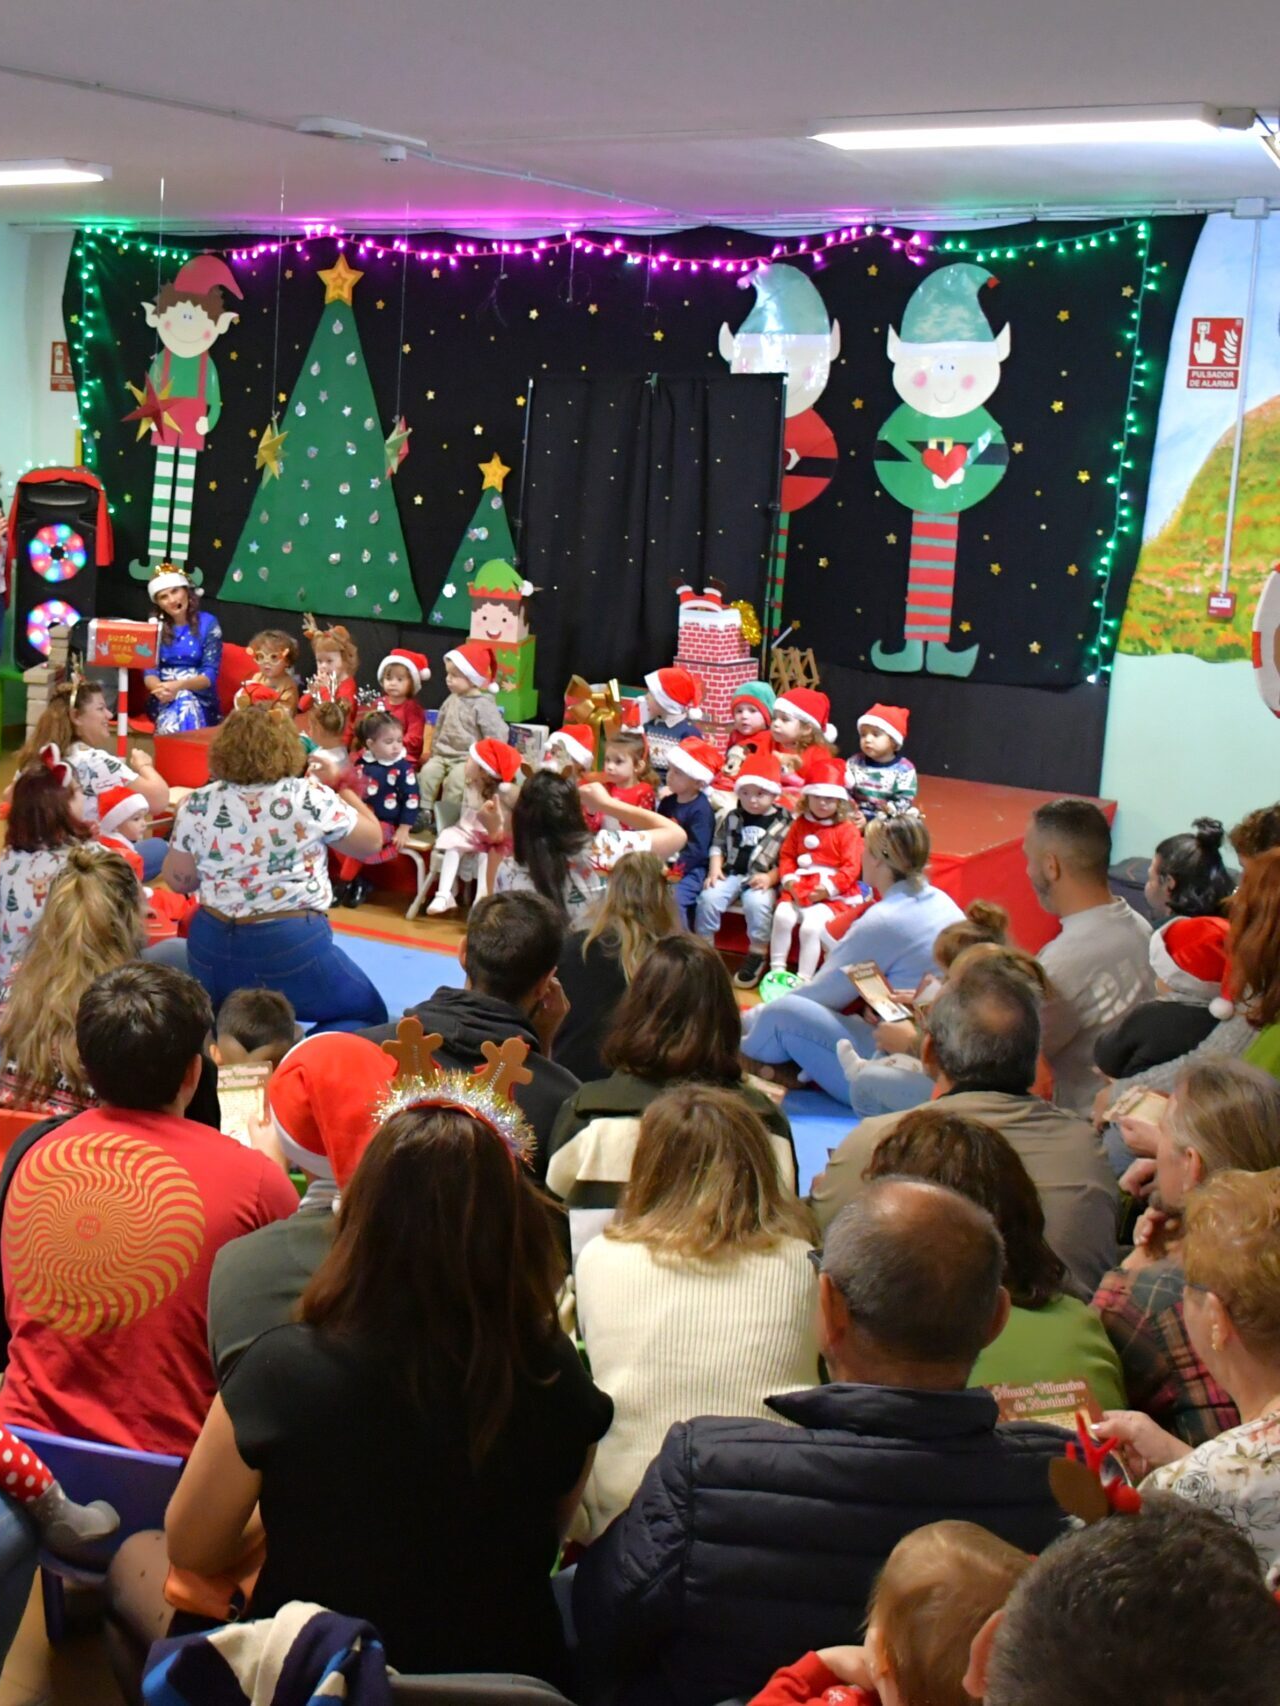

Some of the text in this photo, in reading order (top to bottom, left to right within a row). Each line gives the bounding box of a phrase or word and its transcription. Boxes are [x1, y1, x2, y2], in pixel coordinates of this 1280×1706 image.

[1191, 370, 1234, 379] PULSADOR
[1189, 379, 1235, 388] DE ALARMA
